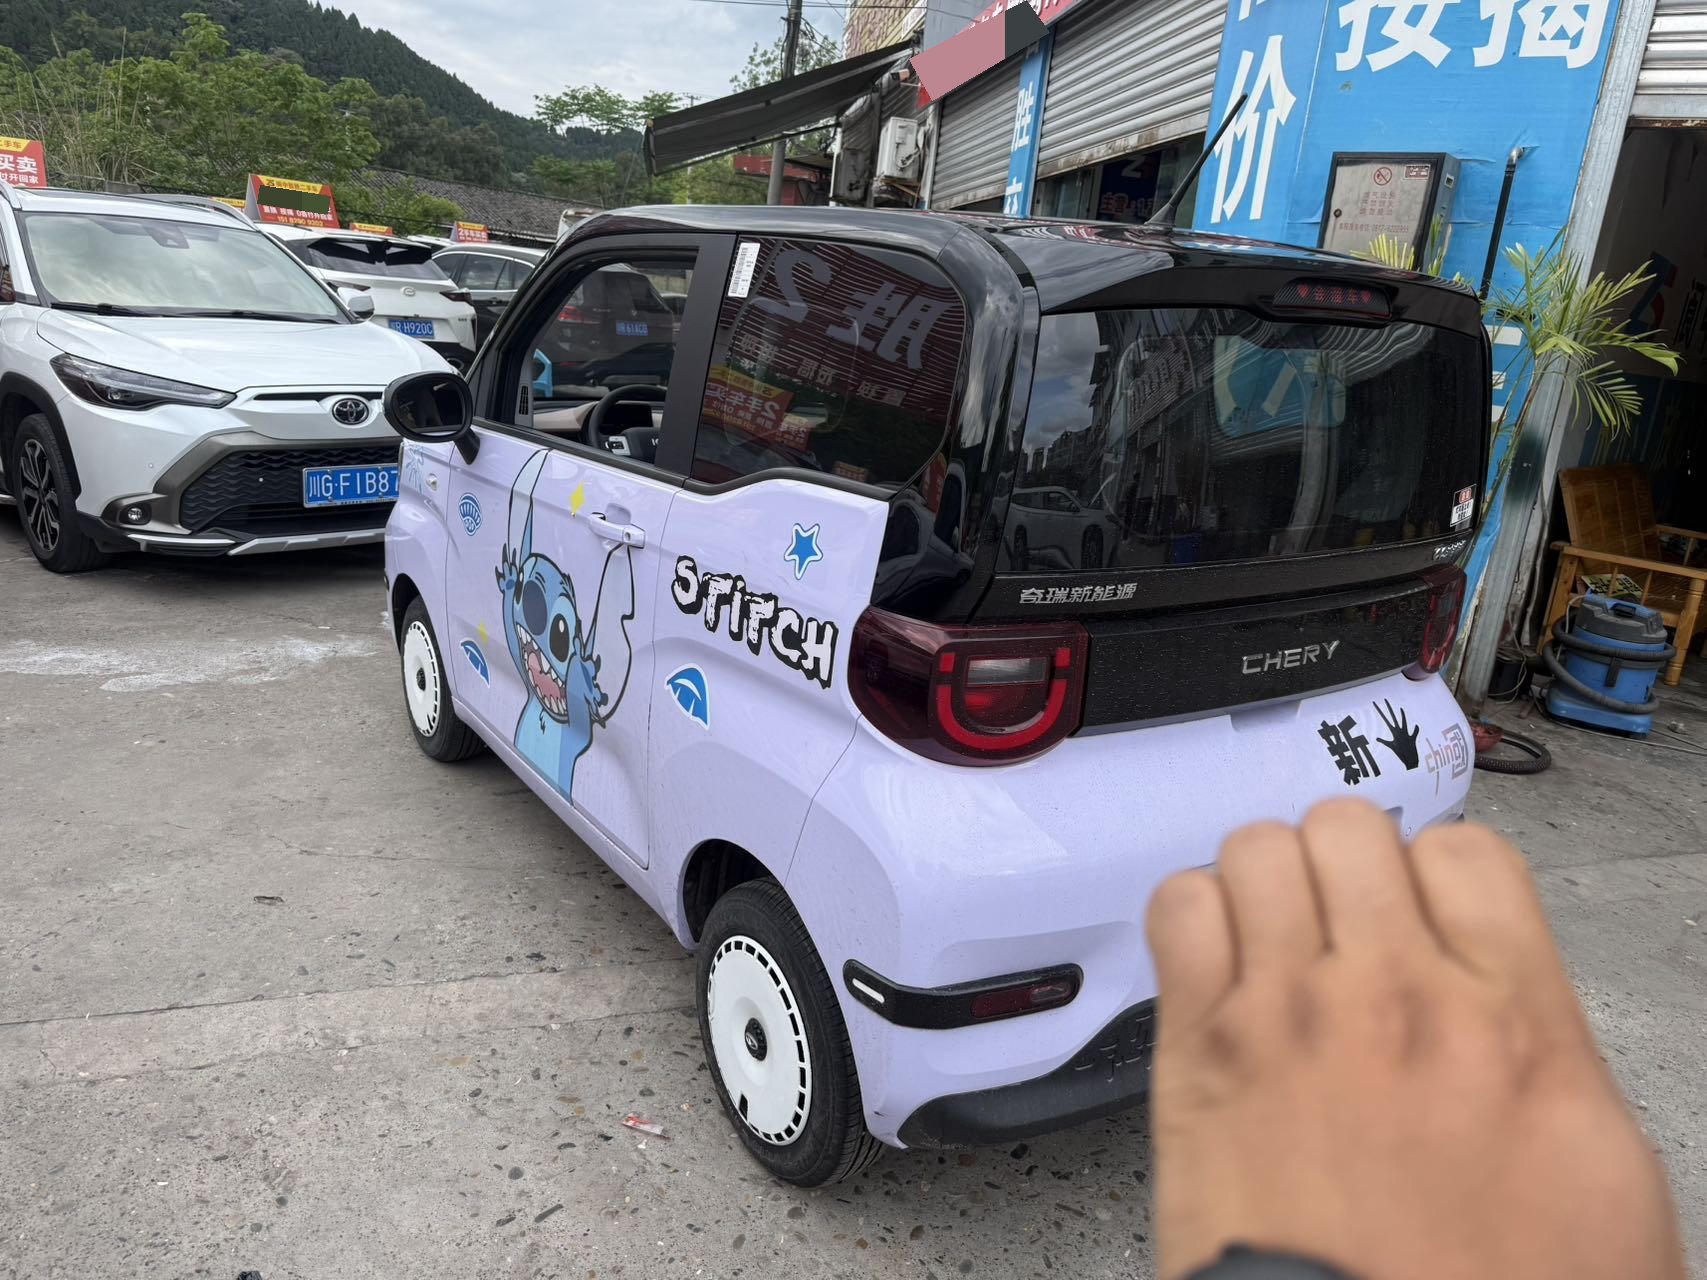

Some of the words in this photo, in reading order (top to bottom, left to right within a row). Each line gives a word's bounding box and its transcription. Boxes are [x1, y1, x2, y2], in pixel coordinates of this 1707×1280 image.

[1019, 582, 1138, 604] 奇瑞新能源
[1242, 640, 1340, 674] CHERY
